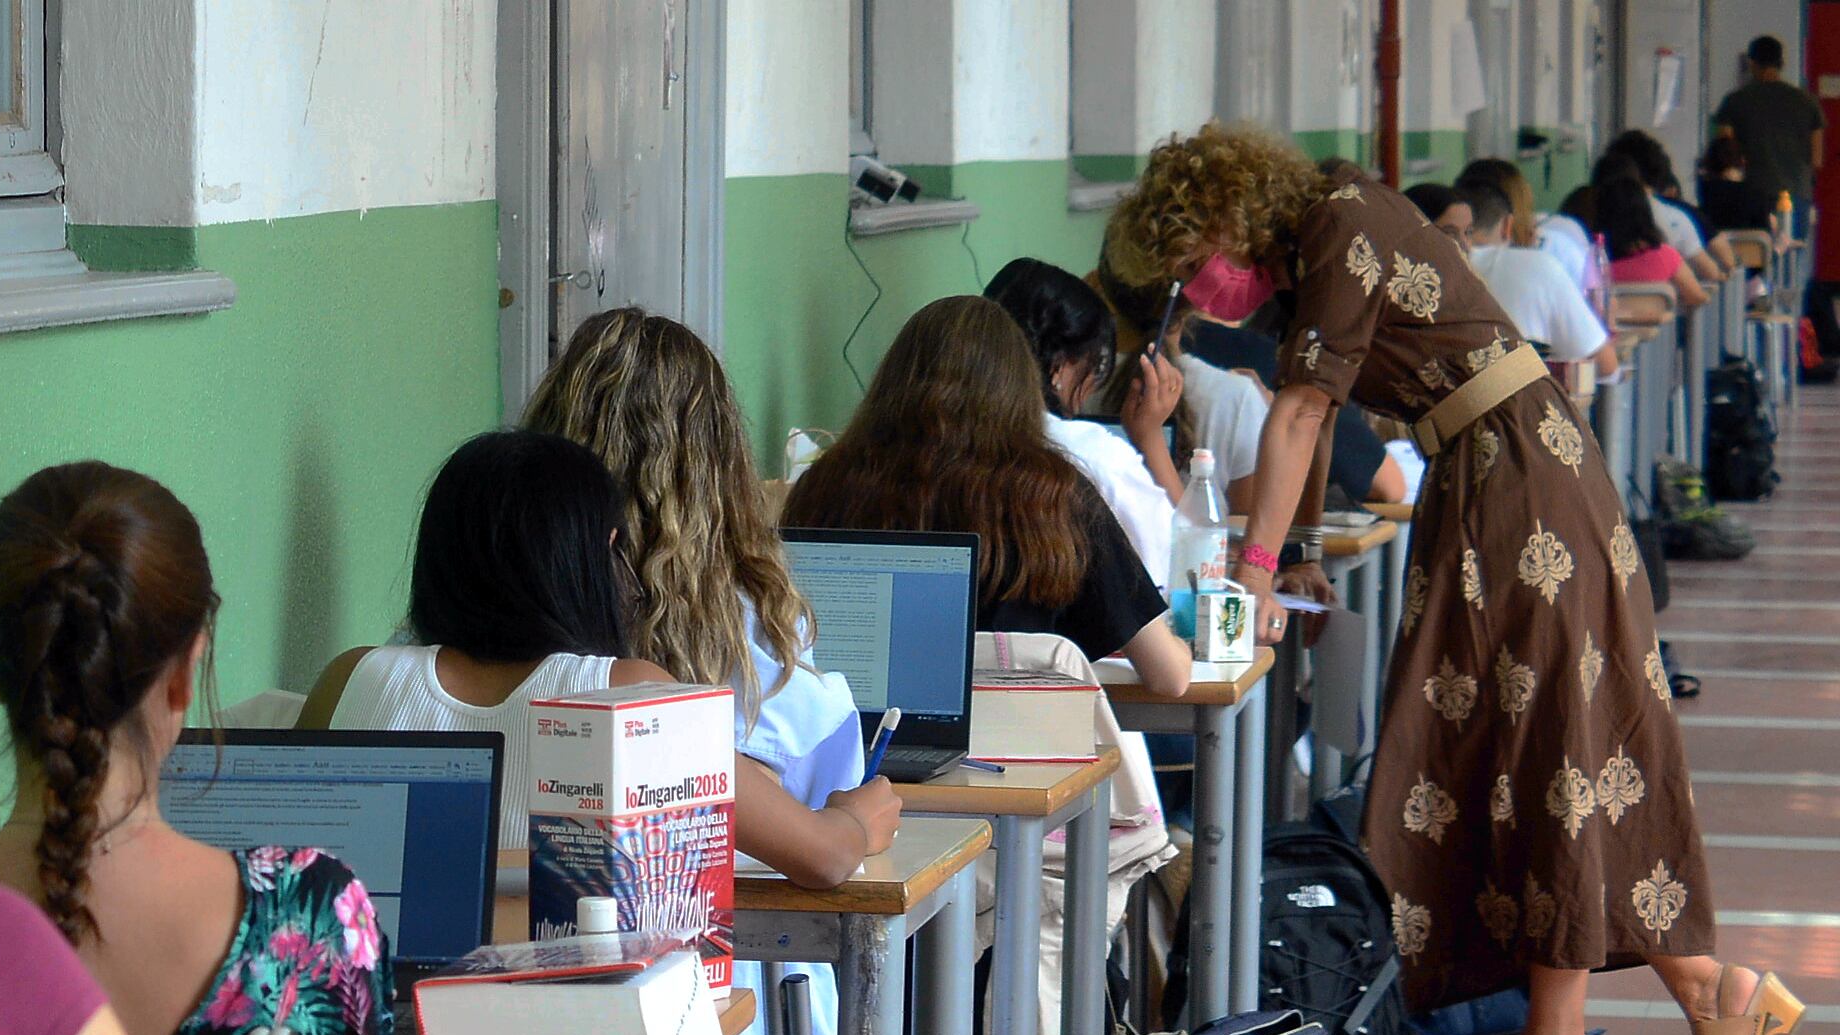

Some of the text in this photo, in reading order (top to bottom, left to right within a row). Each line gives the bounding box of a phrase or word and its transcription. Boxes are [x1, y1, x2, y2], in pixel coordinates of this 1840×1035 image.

[578, 798, 604, 810] 2018
[662, 812, 728, 832] VOCABOLARIO DELLA
[538, 825, 605, 837] VOCABOLARIO DELLA
[675, 825, 728, 843] LINGUA ITALIANA
[551, 834, 604, 845] LINGUA ITALIANA
